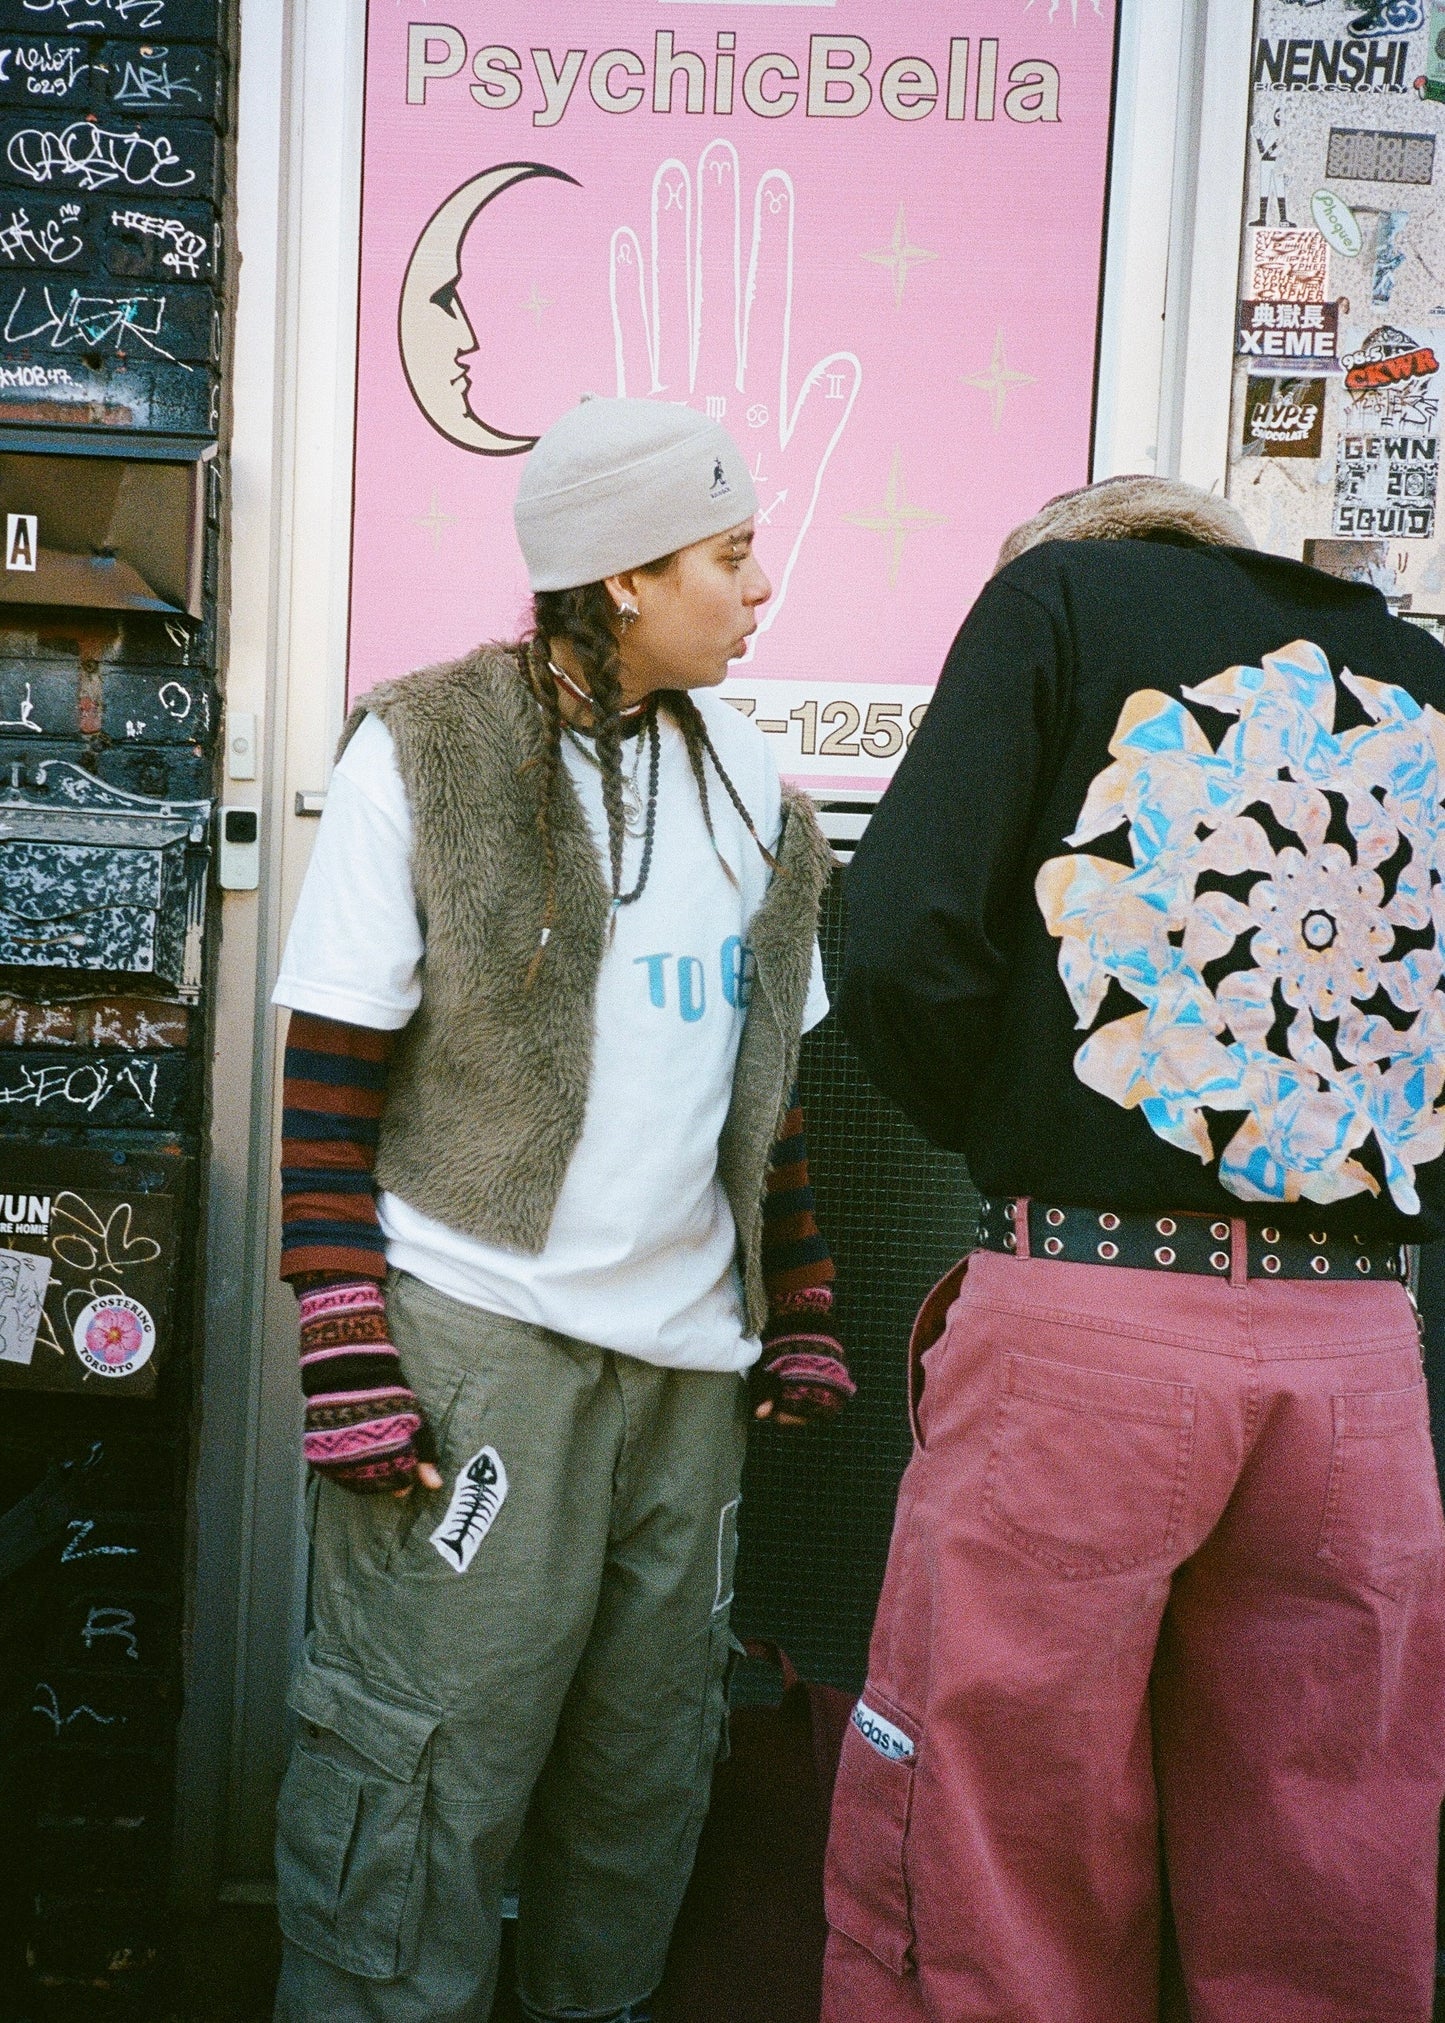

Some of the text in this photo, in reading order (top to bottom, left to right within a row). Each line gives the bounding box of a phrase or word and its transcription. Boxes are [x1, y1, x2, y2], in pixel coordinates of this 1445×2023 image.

[405, 22, 1062, 128] PsychicBella
[1255, 38, 1410, 93] NENSHI
[1253, 81, 1408, 94] BIG DOGS ONLY
[1239, 330, 1335, 357] XEME
[1251, 402, 1319, 430] HYPE
[1252, 426, 1310, 442] CHOCOLATE
[11, 518, 31, 566] A
[15, 1223, 49, 1235] HOMIE
[80, 1346, 133, 1373] TORONTO
